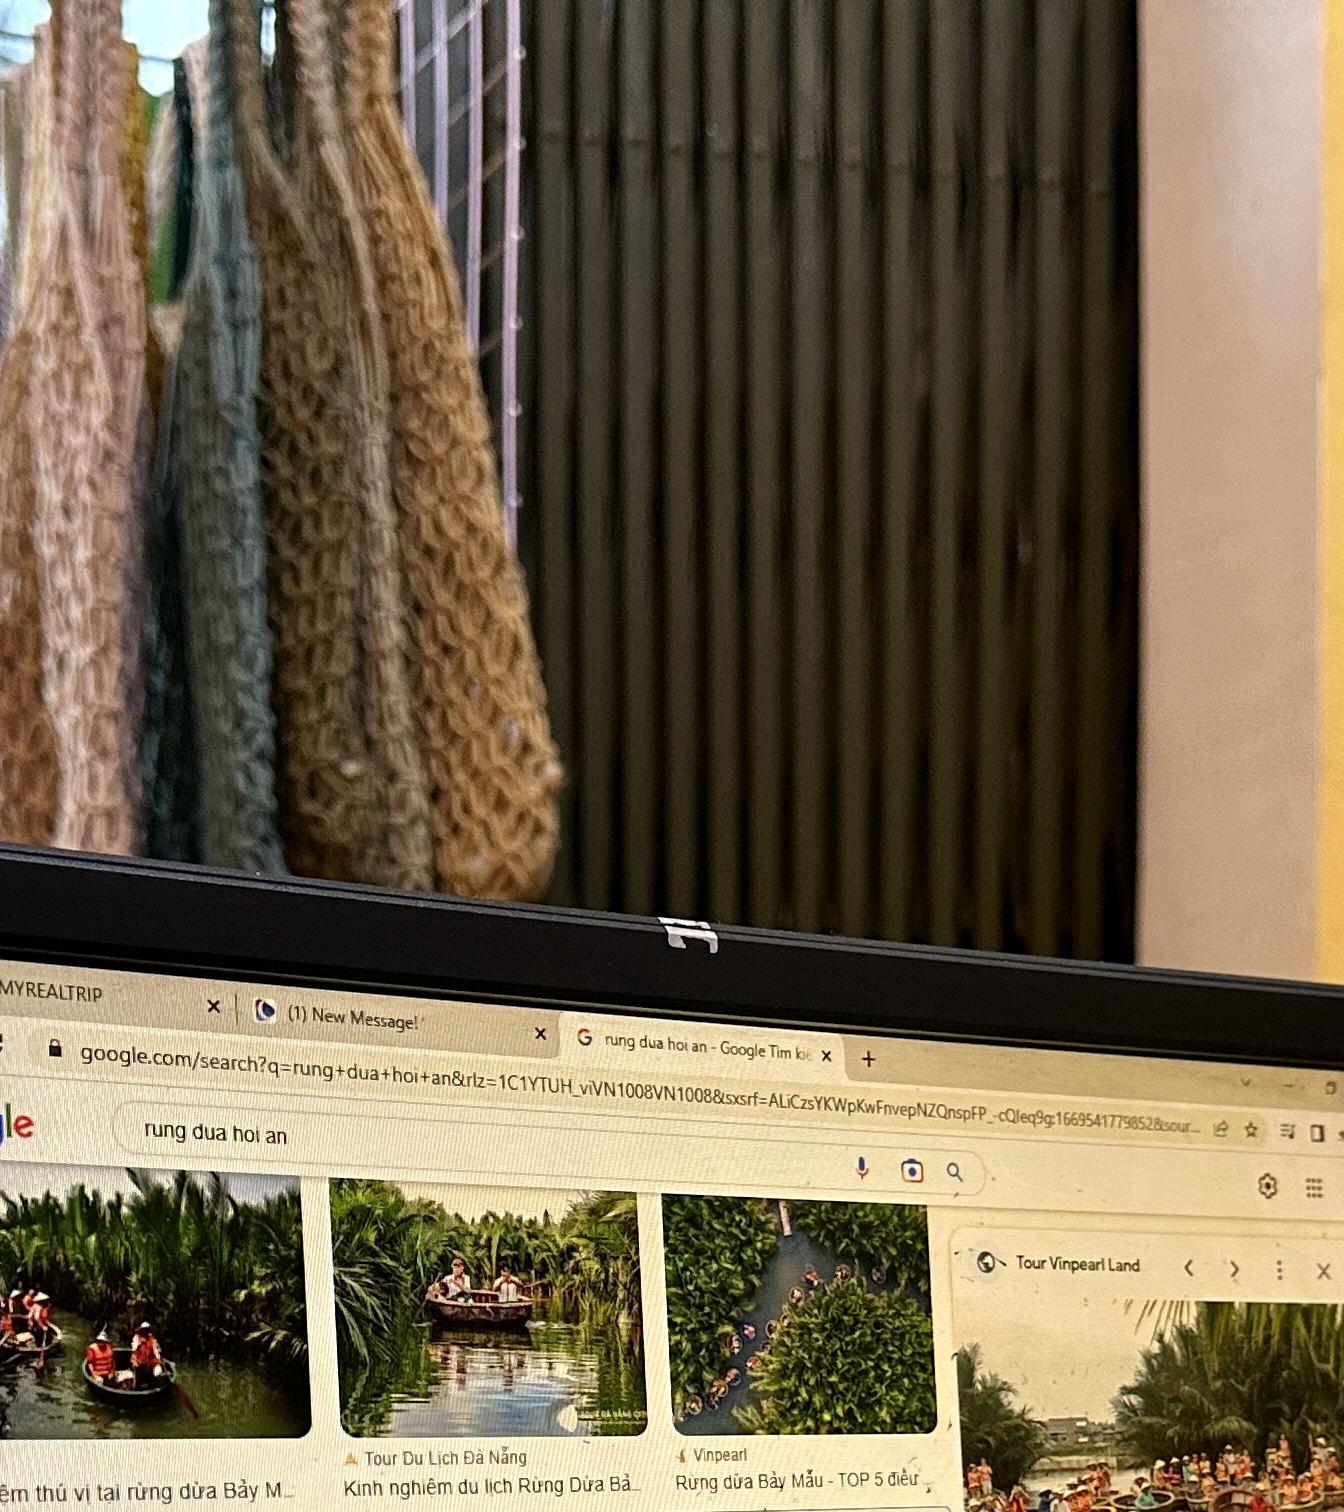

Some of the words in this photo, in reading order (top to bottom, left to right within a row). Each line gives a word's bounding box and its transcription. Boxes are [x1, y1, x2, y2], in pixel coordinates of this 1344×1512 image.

[287, 1003, 308, 1026] (1)
[313, 1006, 346, 1026] New
[351, 1008, 419, 1032] Message!
[605, 1035, 635, 1053] rung
[639, 1036, 664, 1051] dua
[668, 1037, 689, 1052] hoi
[692, 1041, 707, 1053] an
[720, 1041, 766, 1060] Google
[144, 1120, 187, 1144] rung
[192, 1121, 227, 1144] dua
[232, 1124, 260, 1144] hoi
[265, 1128, 287, 1146] an
[1016, 1255, 1047, 1270] Tour
[1049, 1256, 1105, 1276] Vinpearl
[1108, 1258, 1140, 1273] Land
[365, 1452, 397, 1466] Tour
[403, 1451, 423, 1466] Du
[693, 1448, 747, 1463] Vinpearl
[344, 1480, 383, 1497] Kinh
[458, 1478, 479, 1495] du
[840, 1473, 870, 1488] TOP
[874, 1472, 884, 1487] 5
